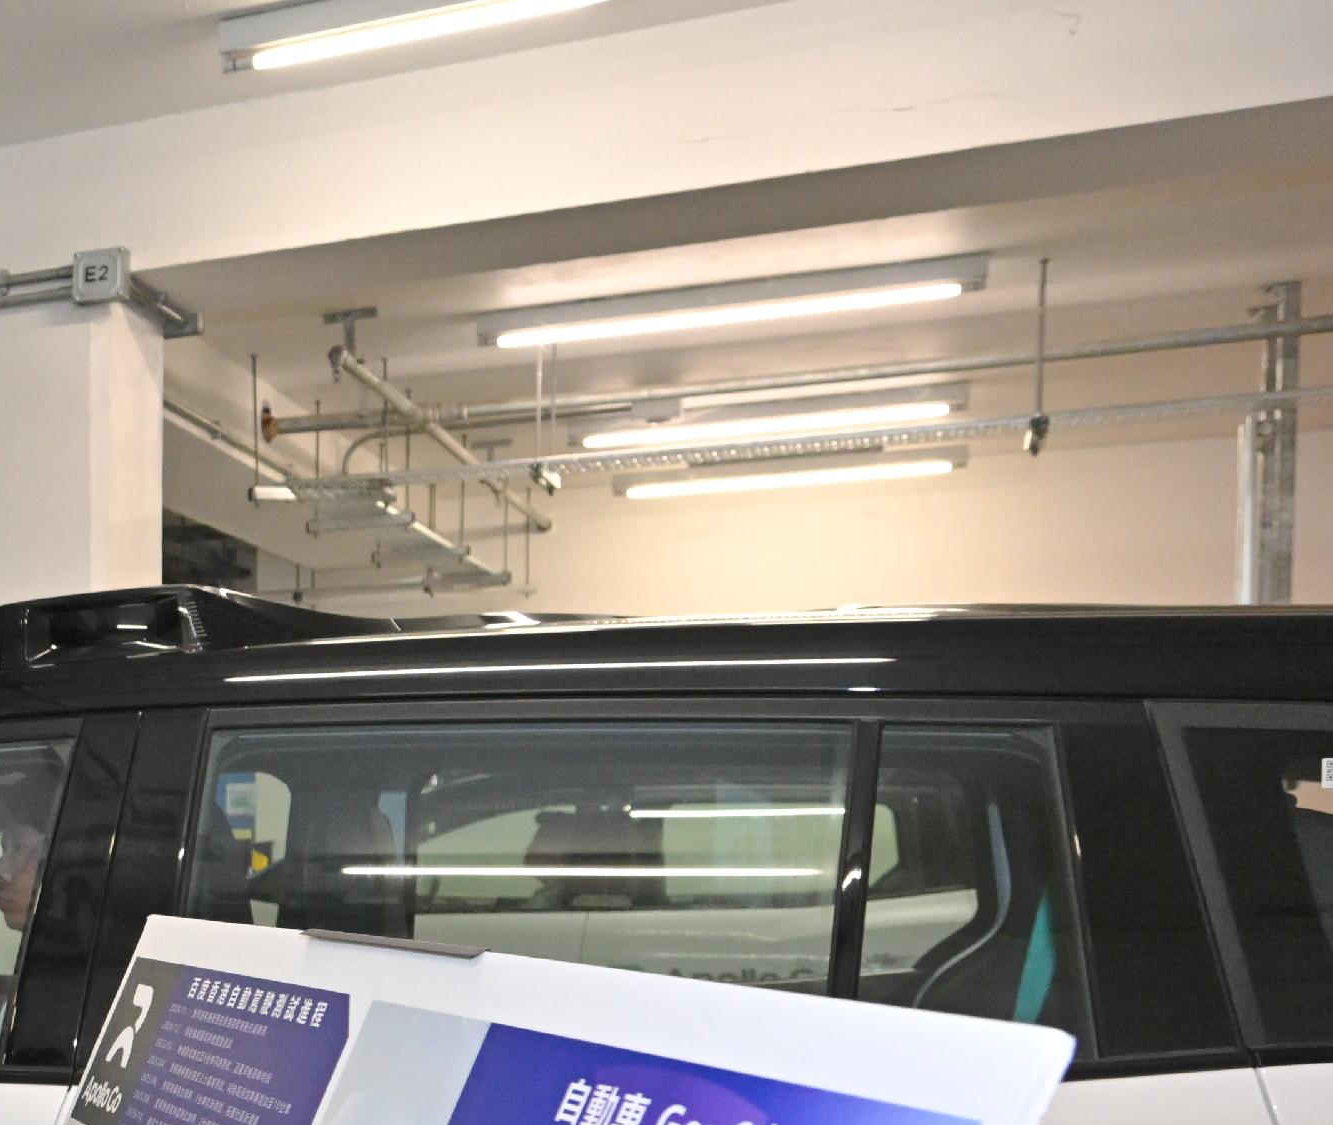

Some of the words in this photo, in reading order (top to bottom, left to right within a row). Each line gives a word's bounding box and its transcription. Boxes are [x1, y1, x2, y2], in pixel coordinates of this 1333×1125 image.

[85, 265, 109, 282] E2
[81, 1075, 110, 1108] Apollo
[105, 1085, 122, 1113] Go
